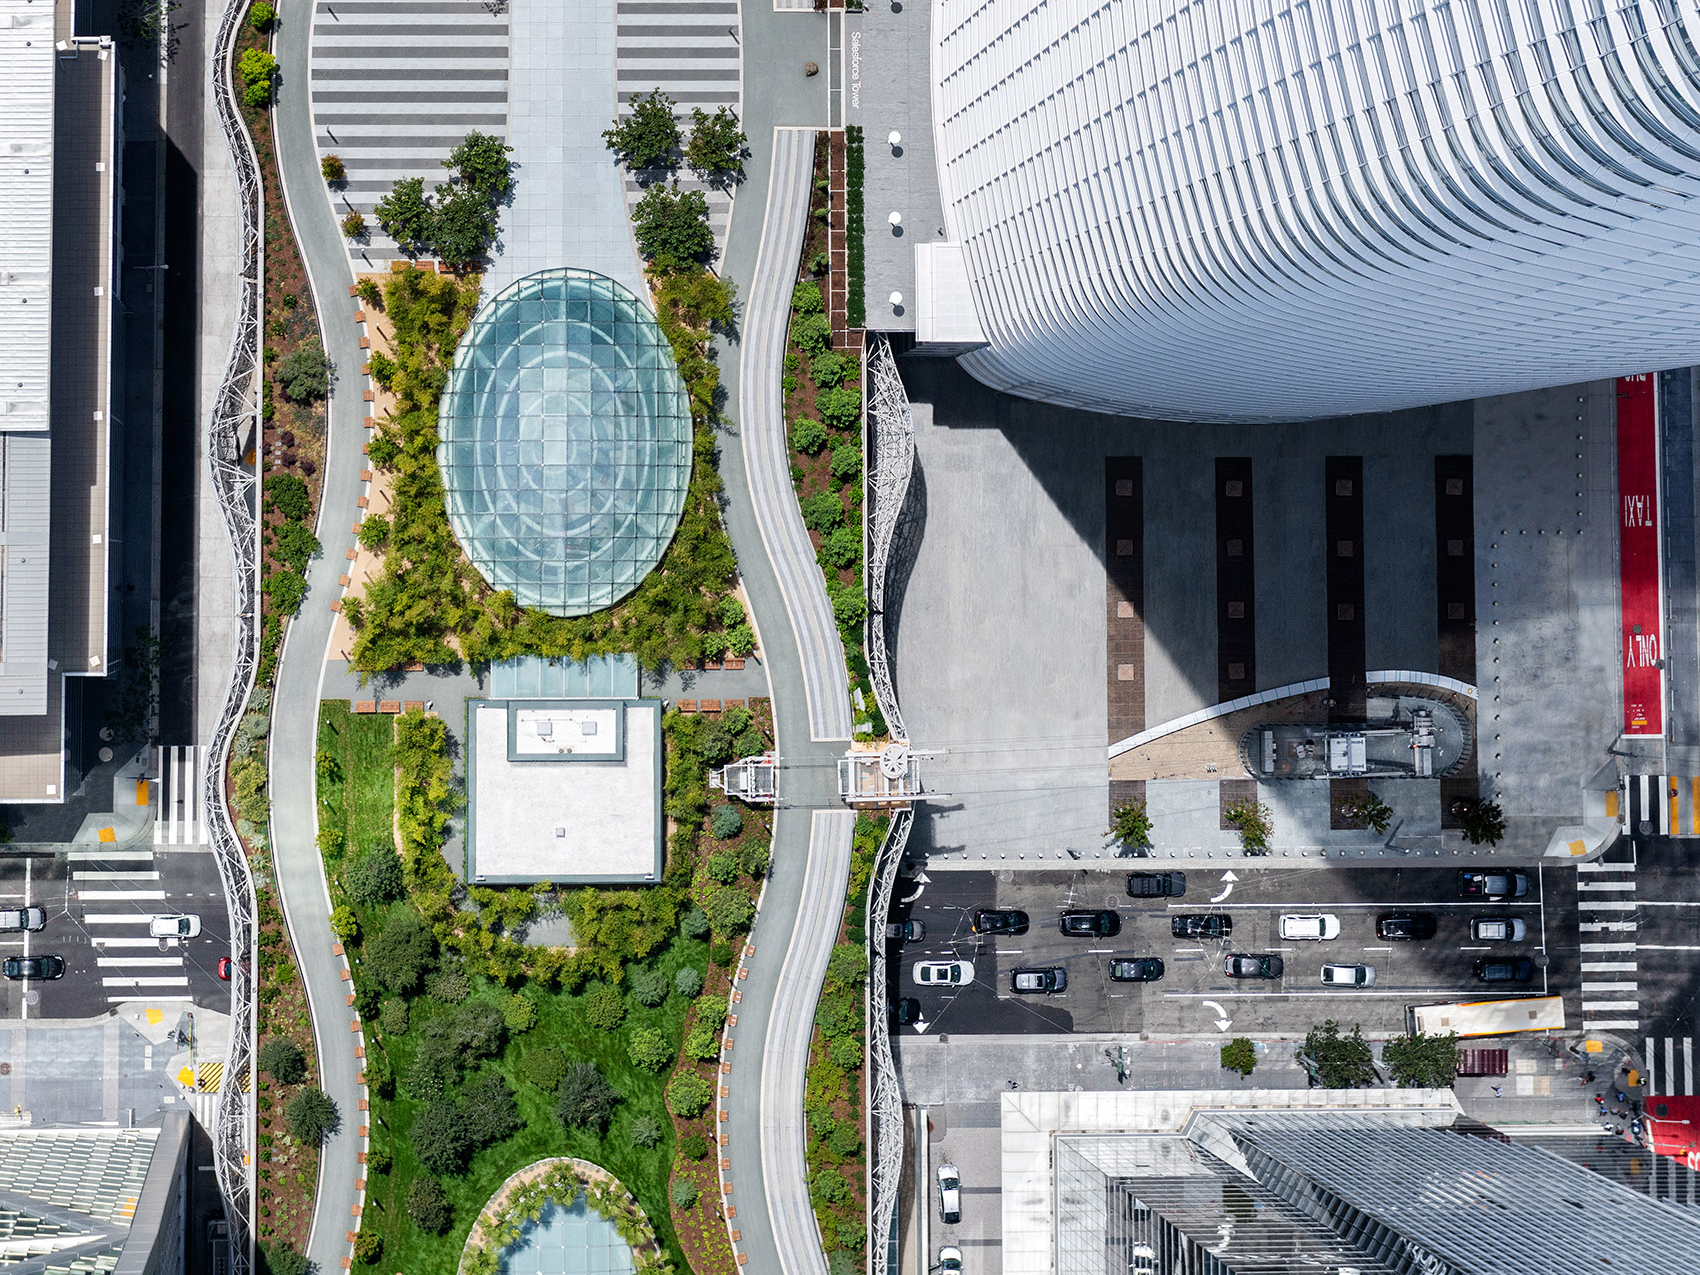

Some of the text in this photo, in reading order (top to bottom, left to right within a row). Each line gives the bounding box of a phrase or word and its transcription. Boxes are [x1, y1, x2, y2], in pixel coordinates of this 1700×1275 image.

[851, 31, 862, 109] Salesforce Tower
[1625, 495, 1652, 527] TAXI
[1627, 634, 1657, 667] ONLY
